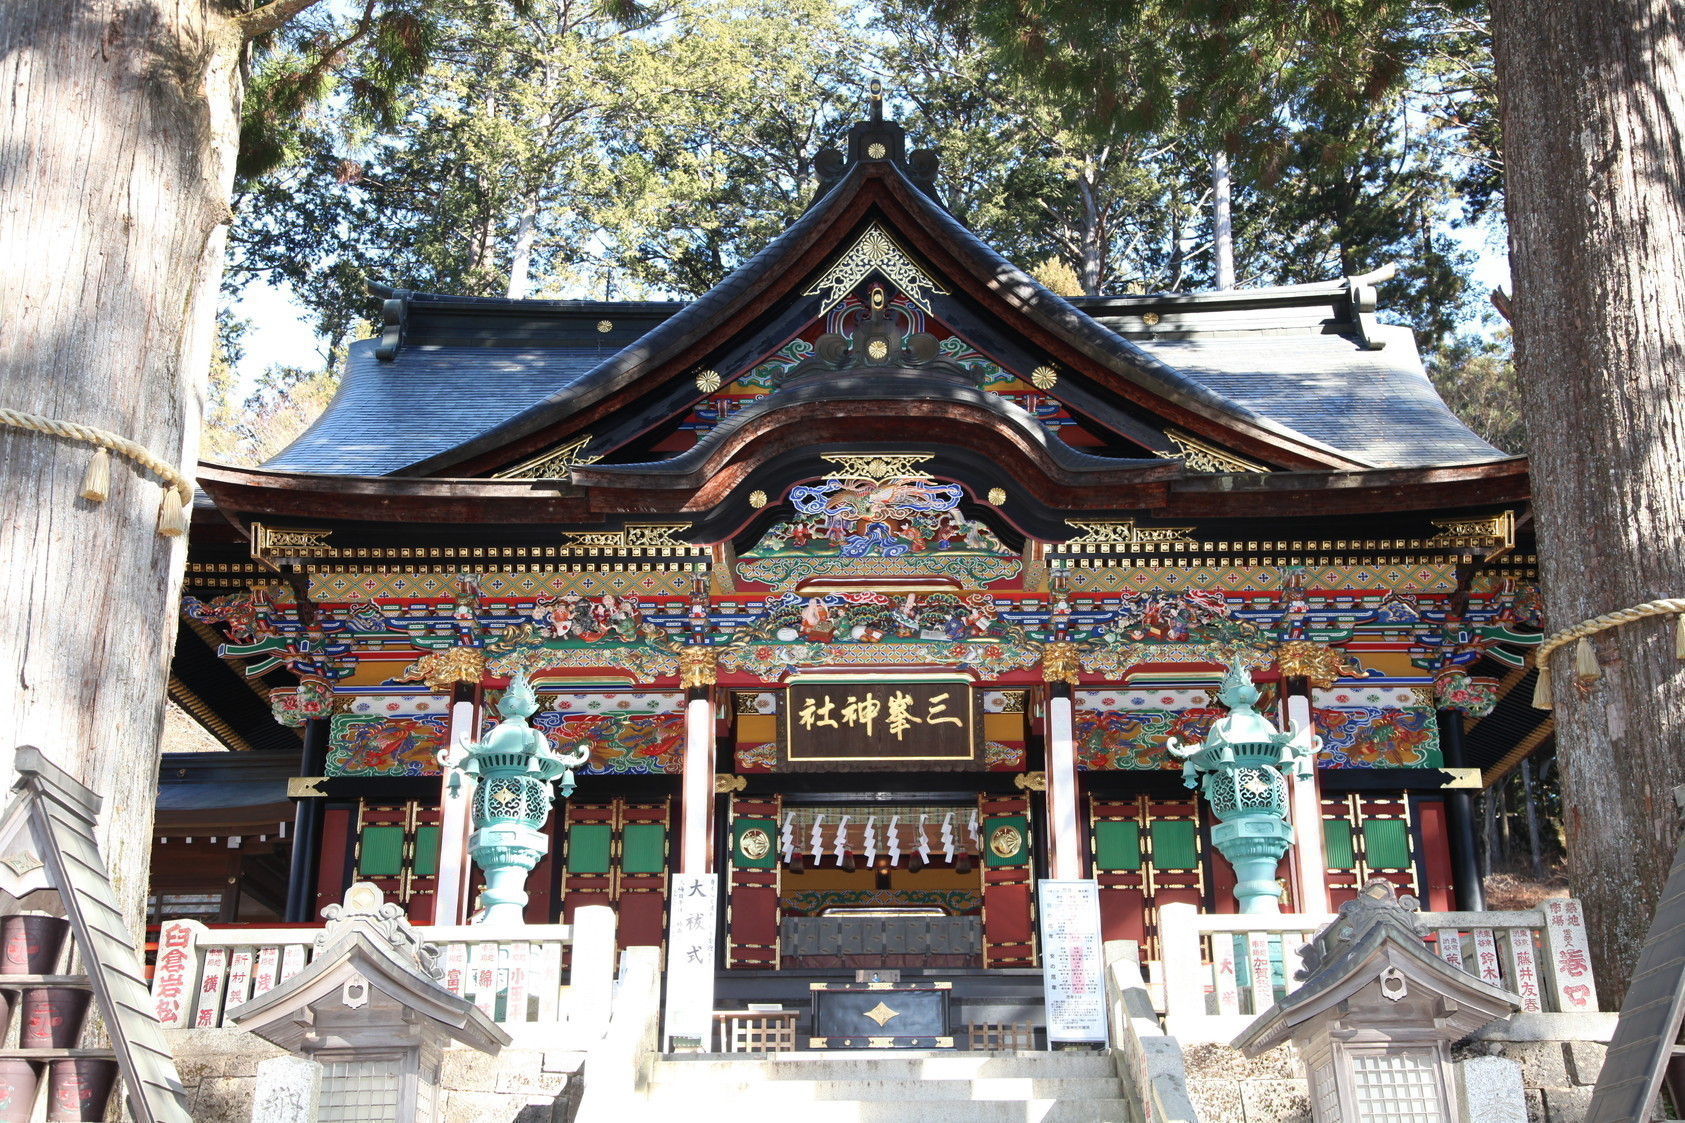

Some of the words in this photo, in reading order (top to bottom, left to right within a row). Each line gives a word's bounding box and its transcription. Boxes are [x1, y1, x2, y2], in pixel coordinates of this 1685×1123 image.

[798, 690, 963, 741] 三峯神社
[685, 878, 707, 966] 大祓式
[1446, 953, 1461, 967] 荒
[1517, 952, 1539, 1012] 藤井友春
